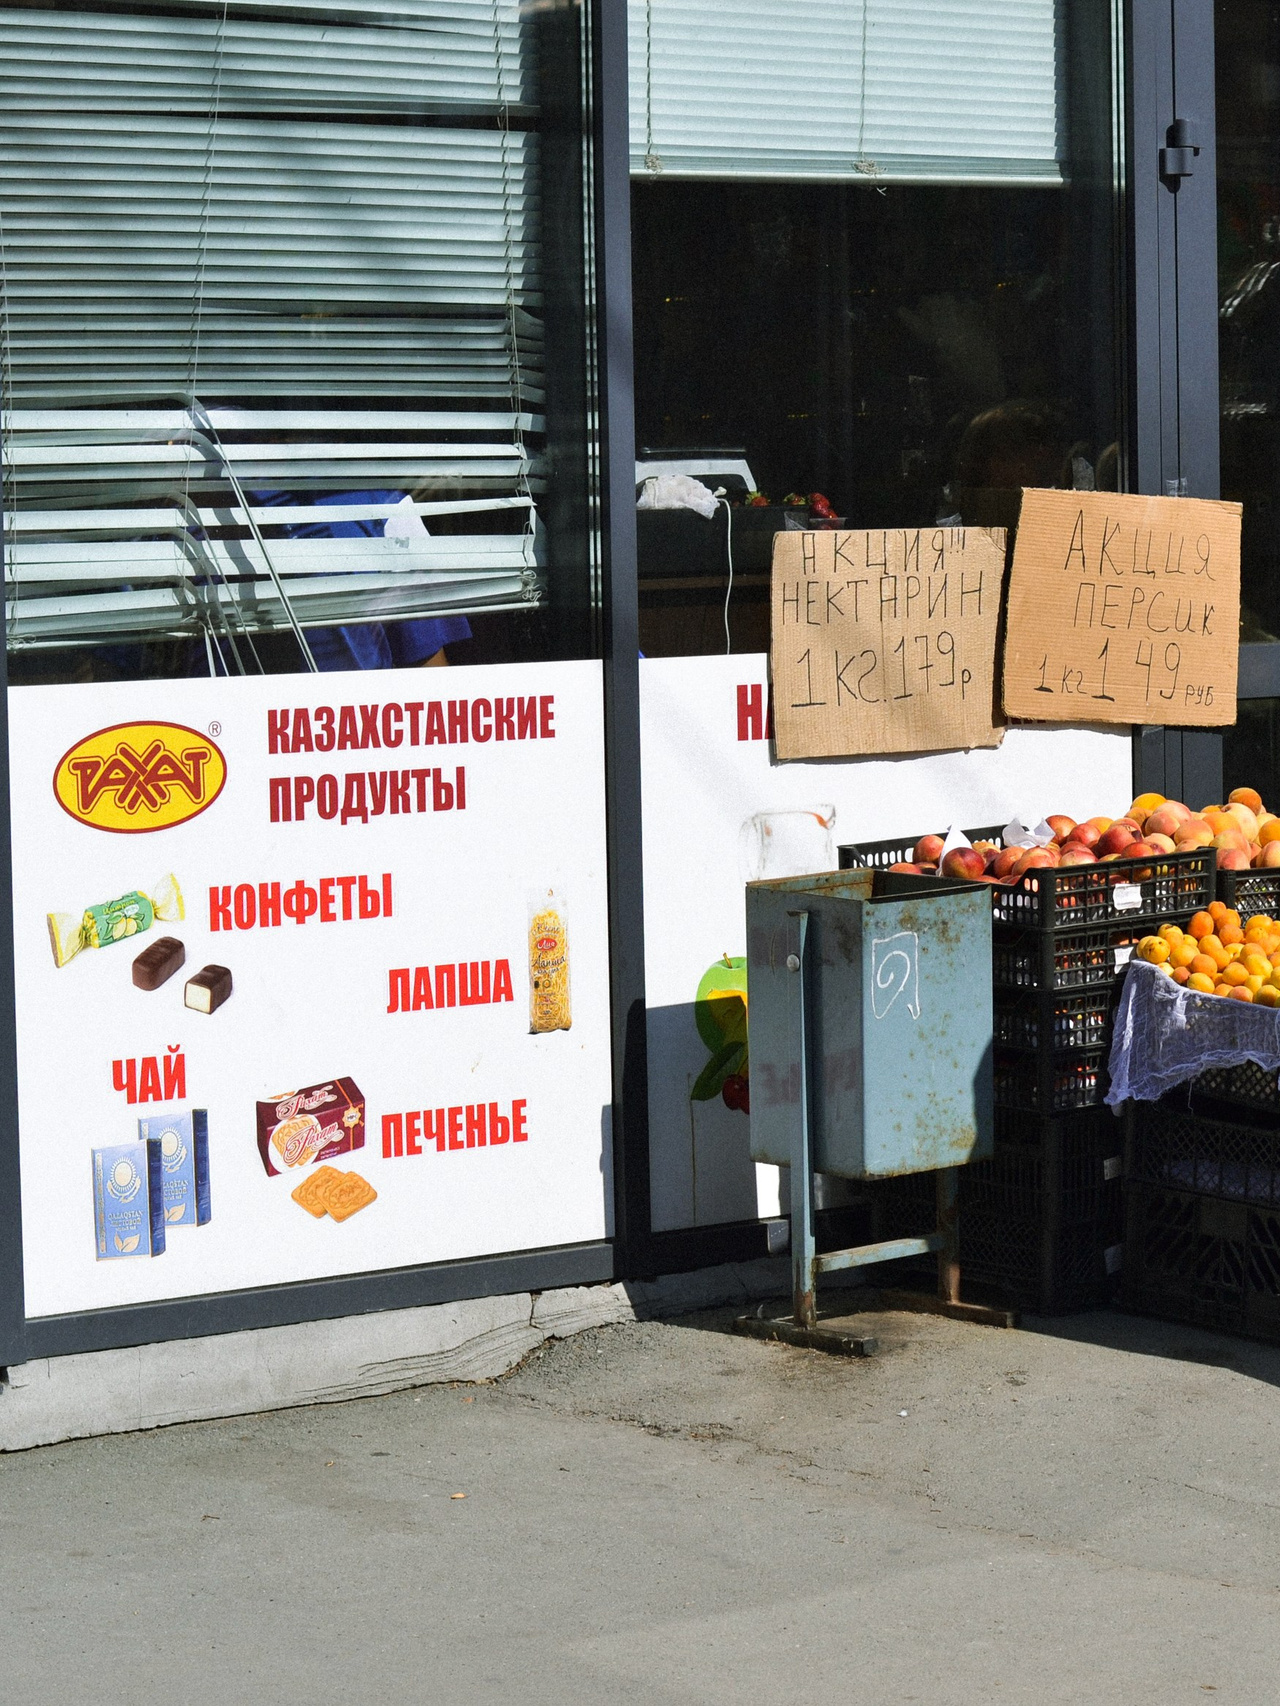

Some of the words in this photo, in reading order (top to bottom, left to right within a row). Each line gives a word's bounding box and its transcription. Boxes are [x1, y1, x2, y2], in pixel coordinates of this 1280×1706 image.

[802, 529, 966, 576] АКЦИЯ!!!
[1064, 509, 1216, 582] АКЦИЯ
[783, 570, 982, 626] НЕКТАРИН
[1074, 582, 1215, 636] ПЕРСИК
[1091, 637, 1181, 702] 149
[268, 696, 555, 754] КАЗАХСТАНСКИЕ
[270, 767, 465, 825] ПРОДУКТЫ
[209, 873, 392, 932] КОНФЕТЫ
[387, 959, 513, 1013] ЛАПША
[112, 1044, 186, 1104] ЧАЙ
[382, 1099, 528, 1158] ПЕЧЕНЬЕ
